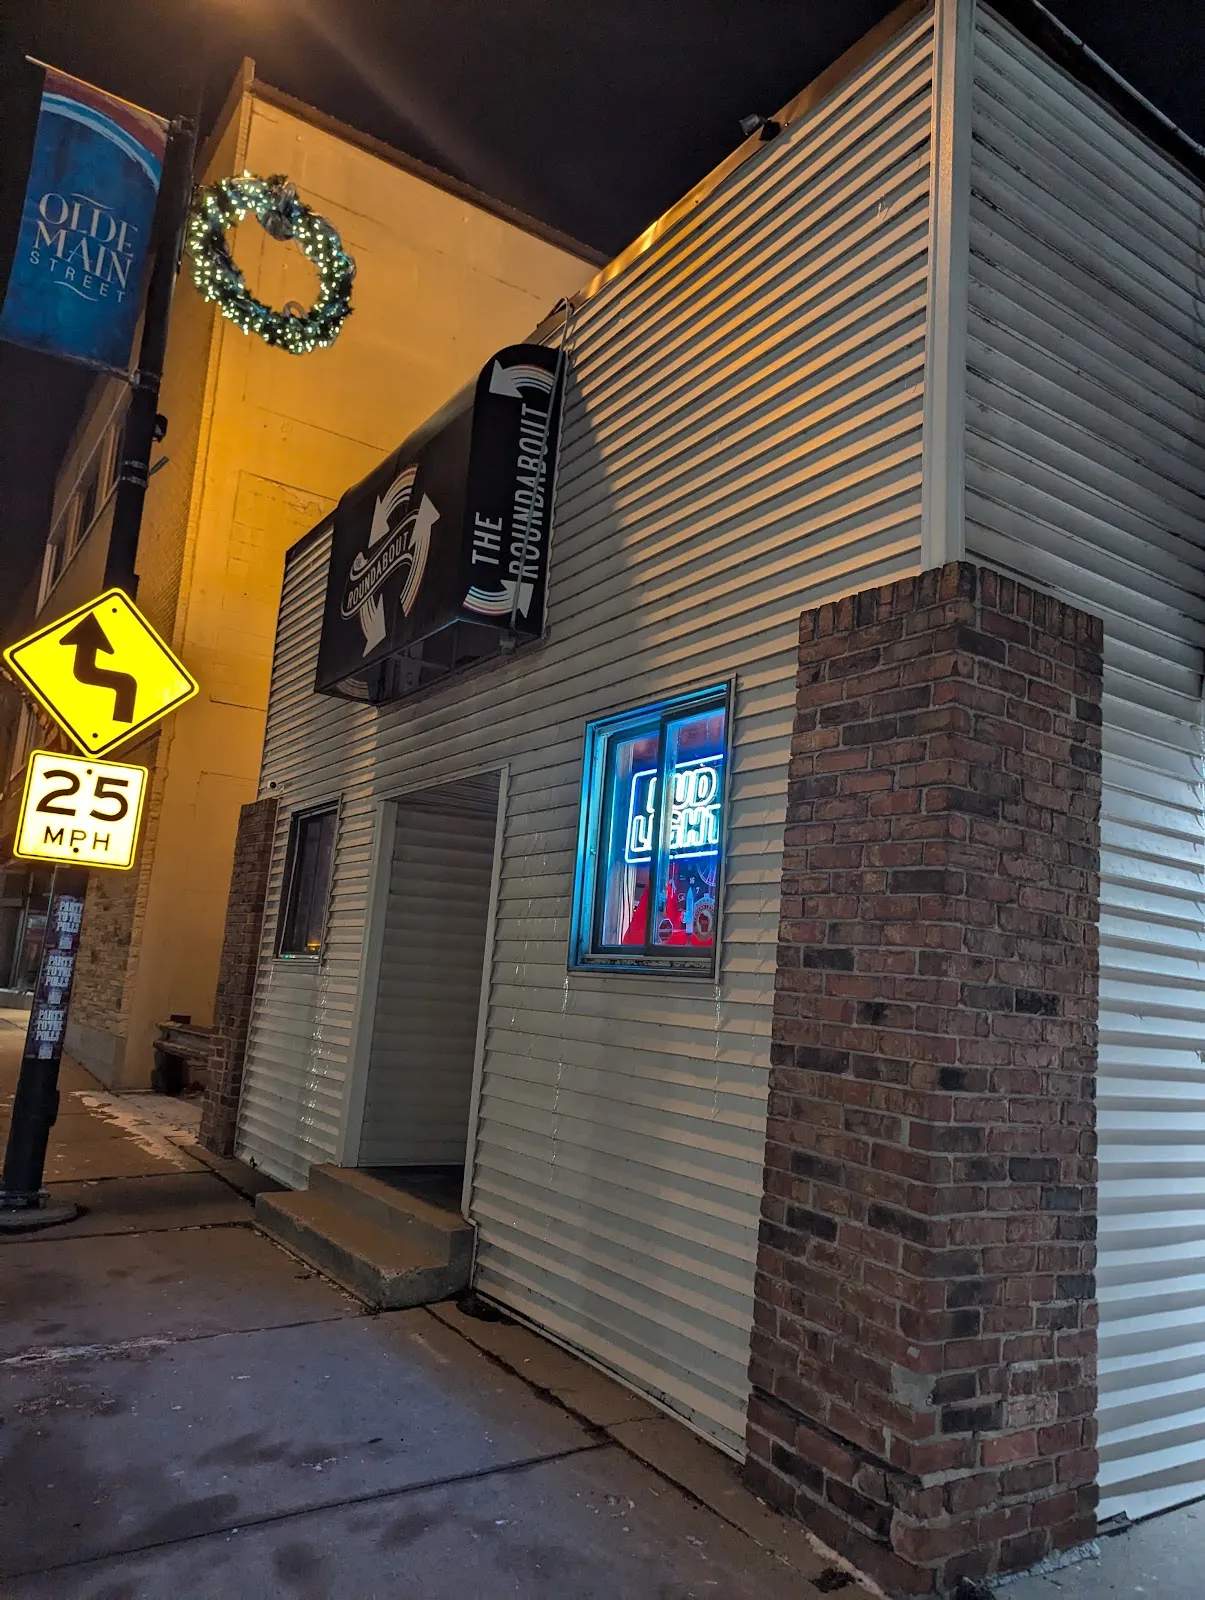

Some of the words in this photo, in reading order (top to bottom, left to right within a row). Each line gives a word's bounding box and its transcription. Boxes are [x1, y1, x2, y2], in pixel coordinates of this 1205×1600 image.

[33, 220, 132, 289] MAIN
[38, 192, 139, 258] OLDE
[29, 249, 127, 303] STREET
[508, 402, 550, 580] ROUNDABOUT
[471, 511, 503, 566] THE
[346, 530, 409, 610] ROUNDABOUT
[36, 769, 129, 822] 25
[43, 825, 111, 851] MPH
